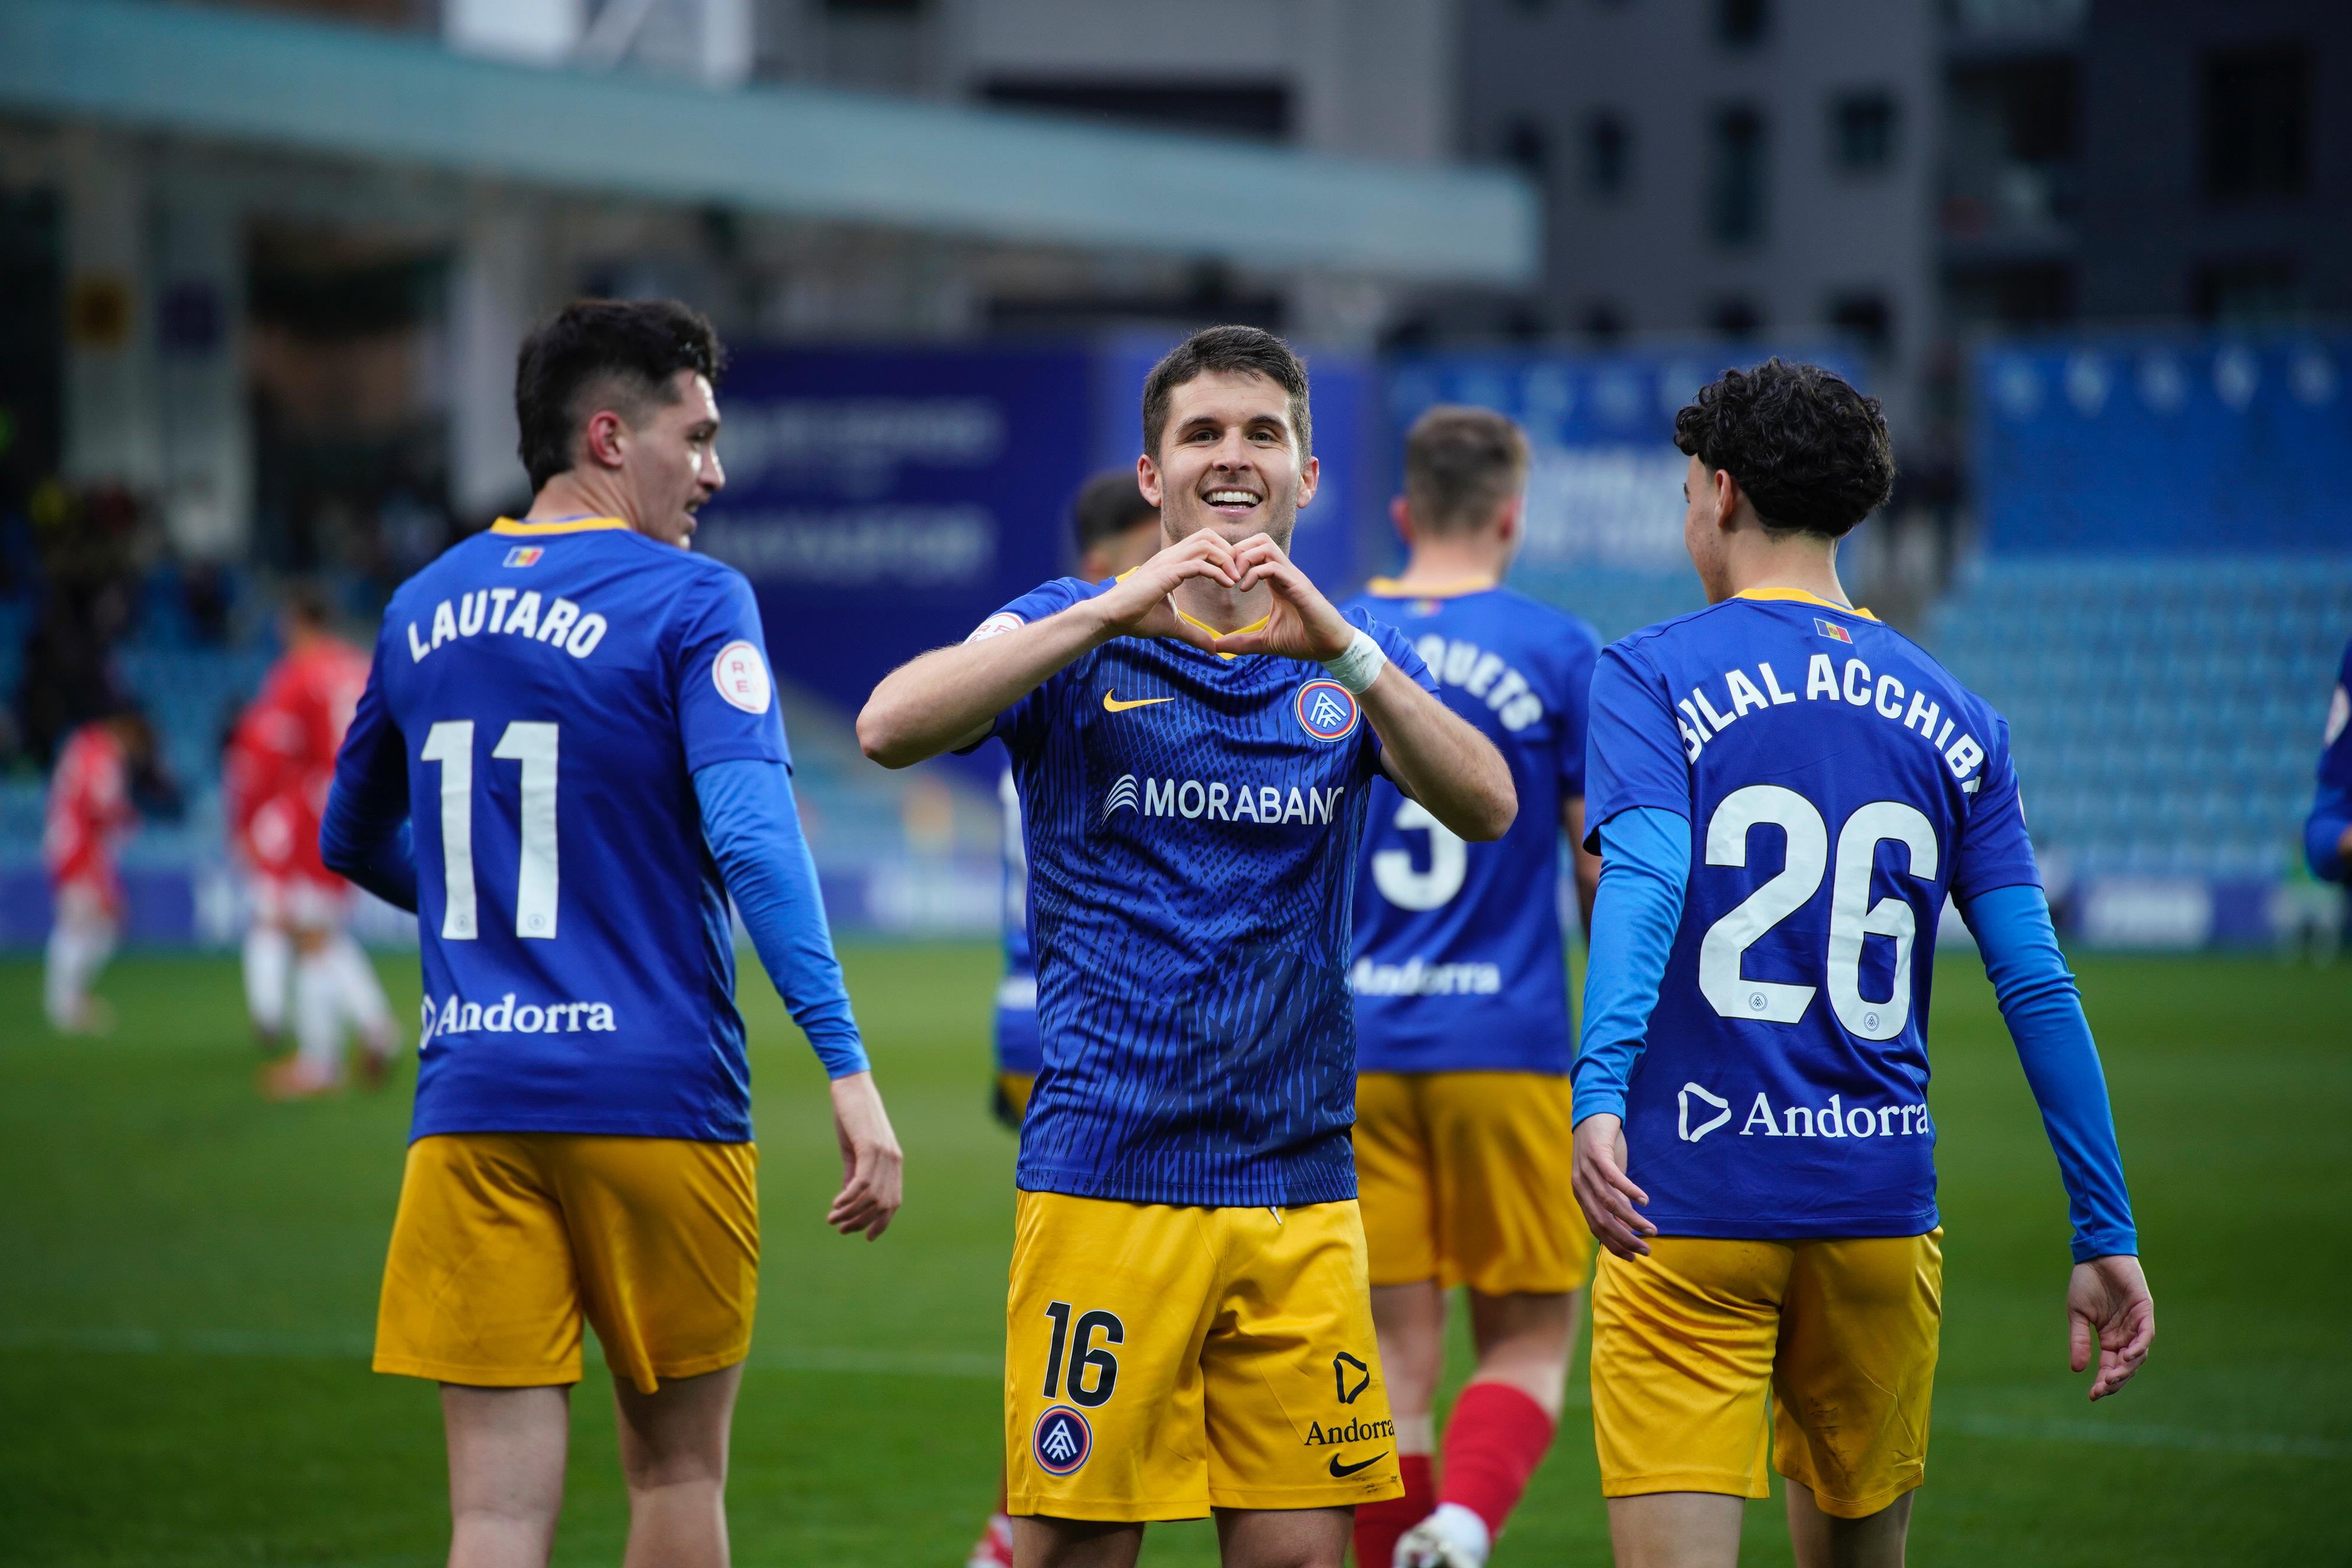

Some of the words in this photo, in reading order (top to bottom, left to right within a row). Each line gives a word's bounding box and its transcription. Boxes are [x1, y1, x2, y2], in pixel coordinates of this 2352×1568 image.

[408, 587, 607, 664] LAUTARO
[1677, 662, 1796, 765] BILAL
[420, 720, 559, 940] 11
[1698, 784, 1939, 1041] 26
[435, 992, 617, 1037] Andorra
[1739, 1092, 1929, 1138] Andorra
[1043, 1300, 1125, 1409] 16
[1304, 1417, 1394, 1446] Andorra
